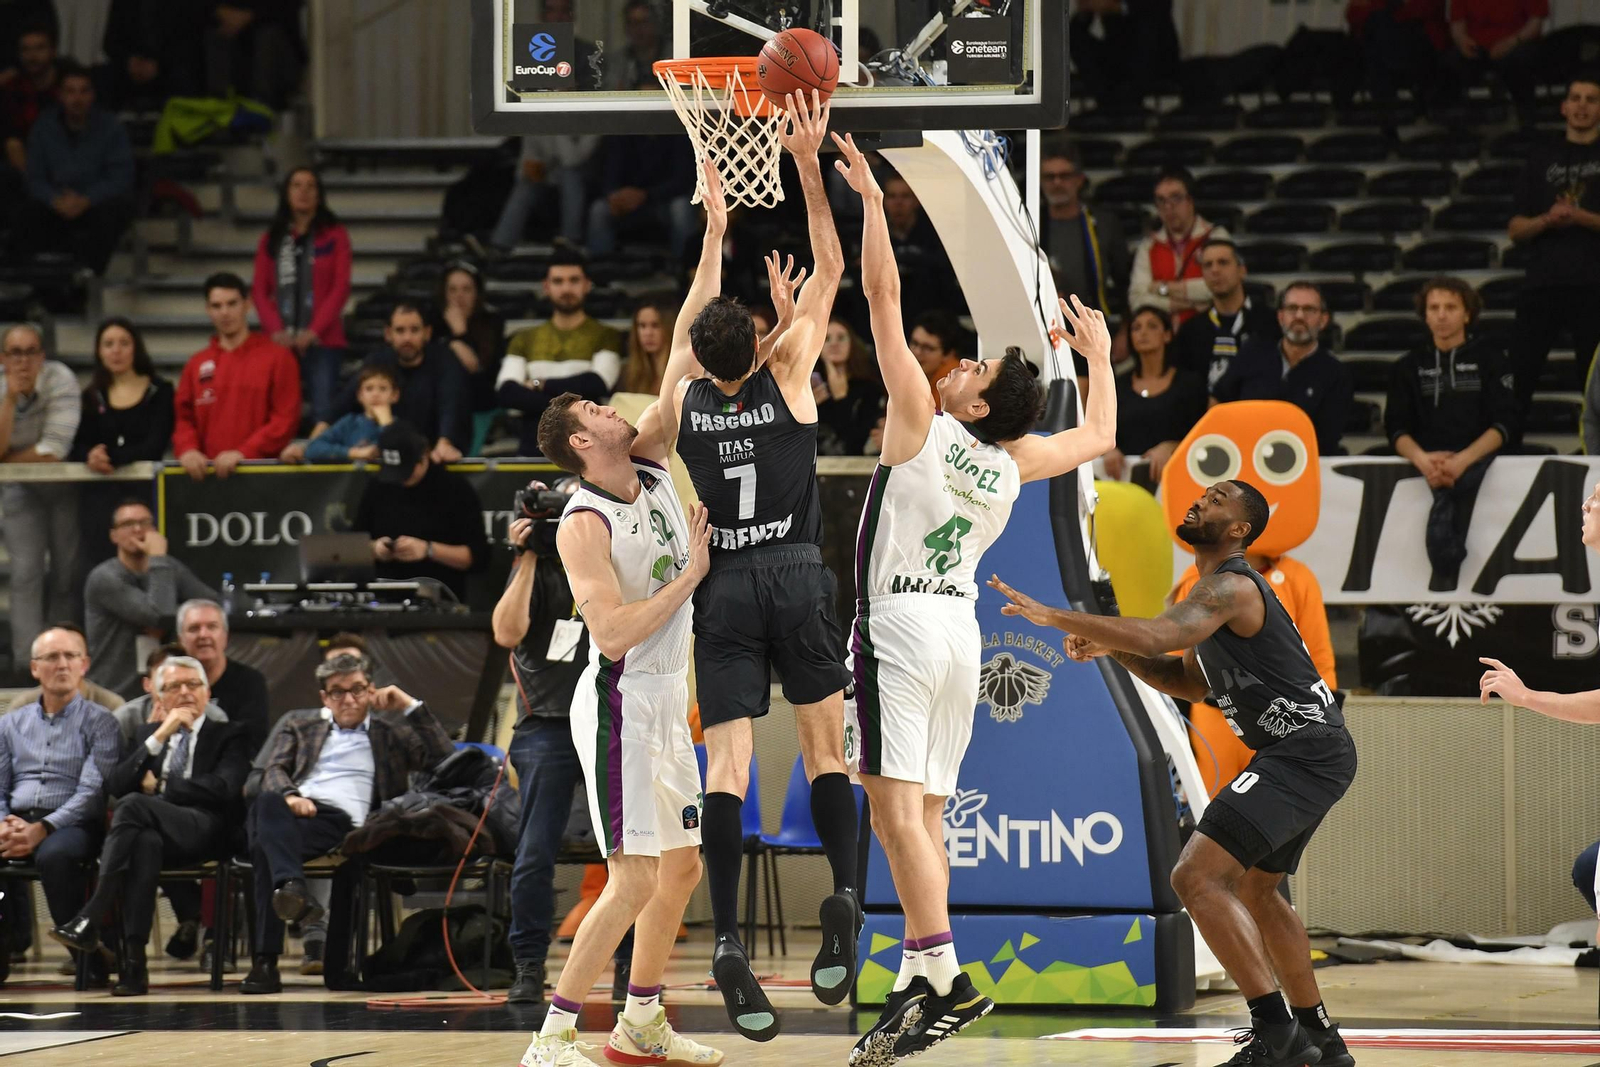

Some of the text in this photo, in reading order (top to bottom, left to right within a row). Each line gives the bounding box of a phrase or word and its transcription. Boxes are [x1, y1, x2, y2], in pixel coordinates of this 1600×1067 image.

[966, 45, 1007, 53] oneteam
[515, 65, 556, 76] EuroCup
[690, 402, 775, 432] PASCOLO
[718, 438, 754, 455] ITAS
[719, 451, 756, 464] MUTUA
[723, 463, 757, 520] 7
[1004, 631, 1065, 668] BASKET
